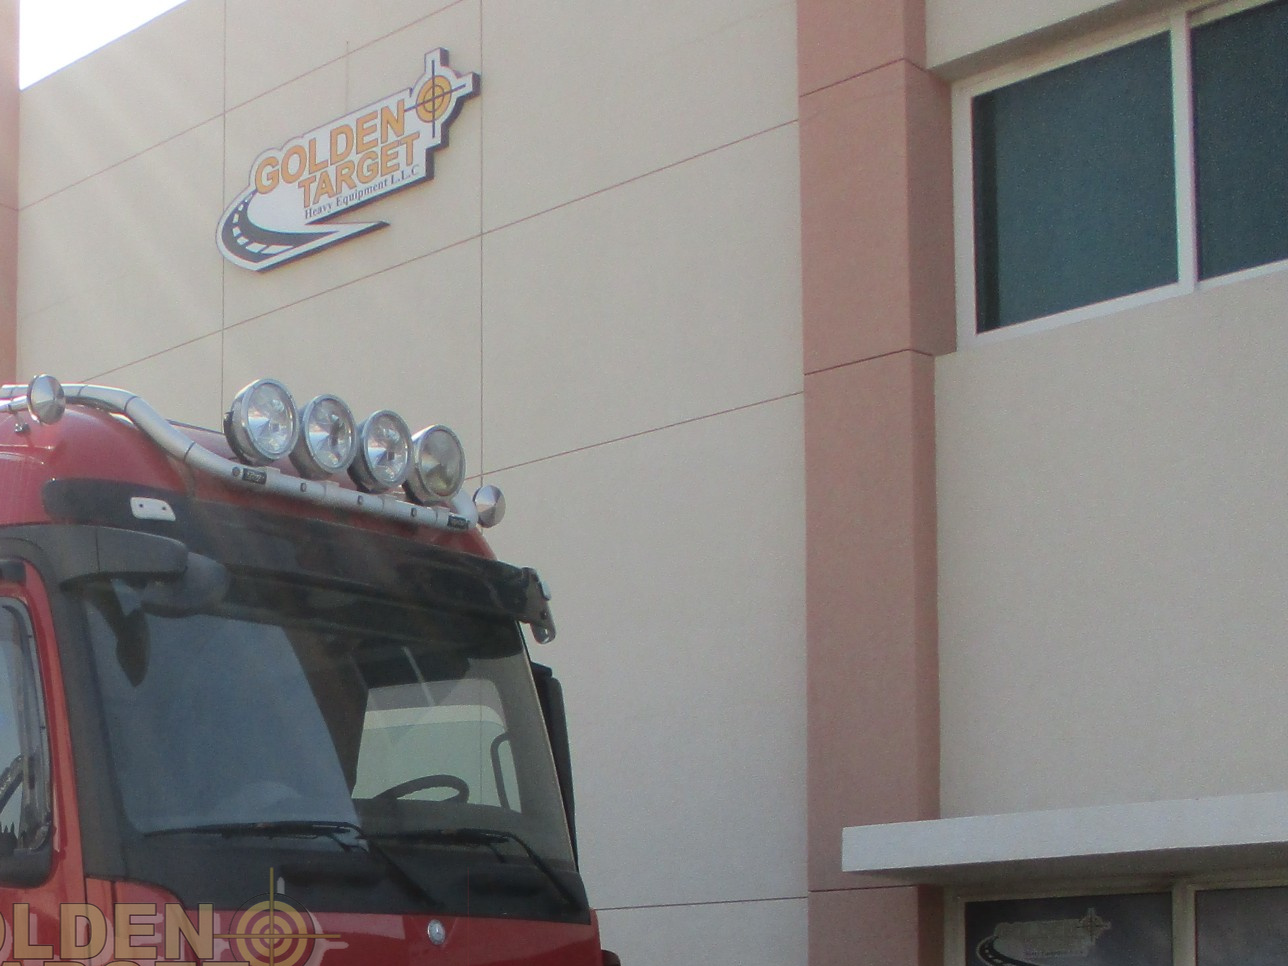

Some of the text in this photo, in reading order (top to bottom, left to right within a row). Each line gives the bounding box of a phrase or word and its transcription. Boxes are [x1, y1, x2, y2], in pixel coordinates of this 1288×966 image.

[254, 99, 406, 194] GOLDEN
[297, 131, 421, 208] TARGET
[304, 201, 333, 220] Heavy
[335, 177, 388, 207] Equipment
